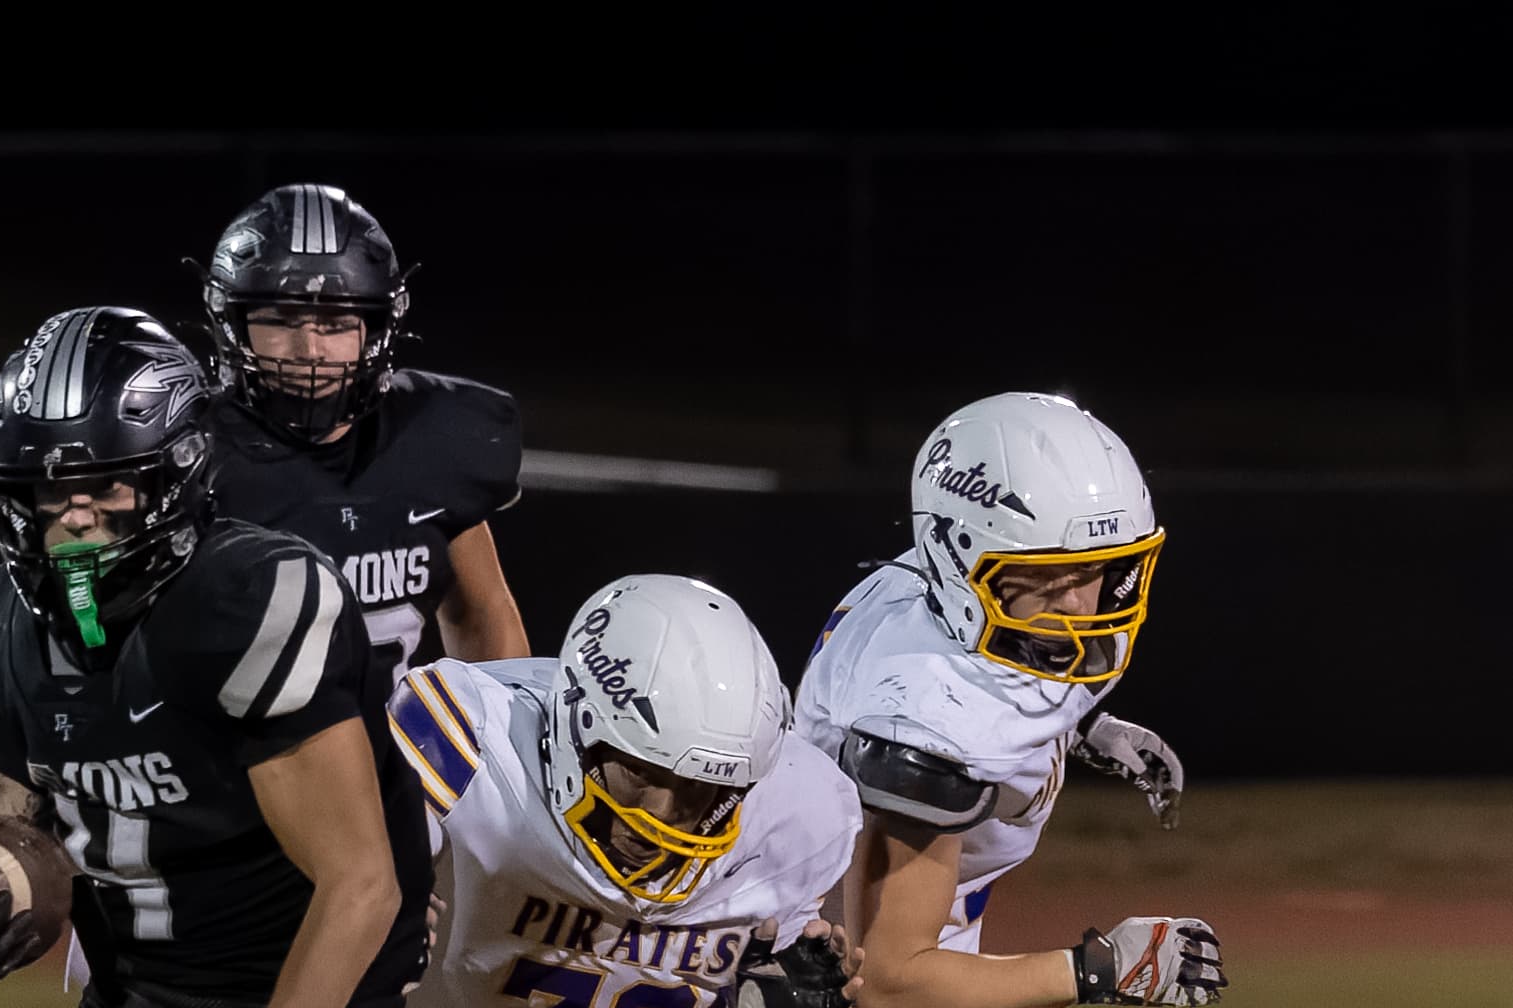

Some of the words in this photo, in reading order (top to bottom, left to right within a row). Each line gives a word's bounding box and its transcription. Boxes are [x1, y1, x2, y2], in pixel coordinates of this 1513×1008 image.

[919, 438, 1002, 508] Prates
[1088, 518, 1119, 537] LTW
[571, 608, 637, 710] Pirates
[702, 761, 739, 777] LTW
[511, 896, 743, 974] PIRATES
